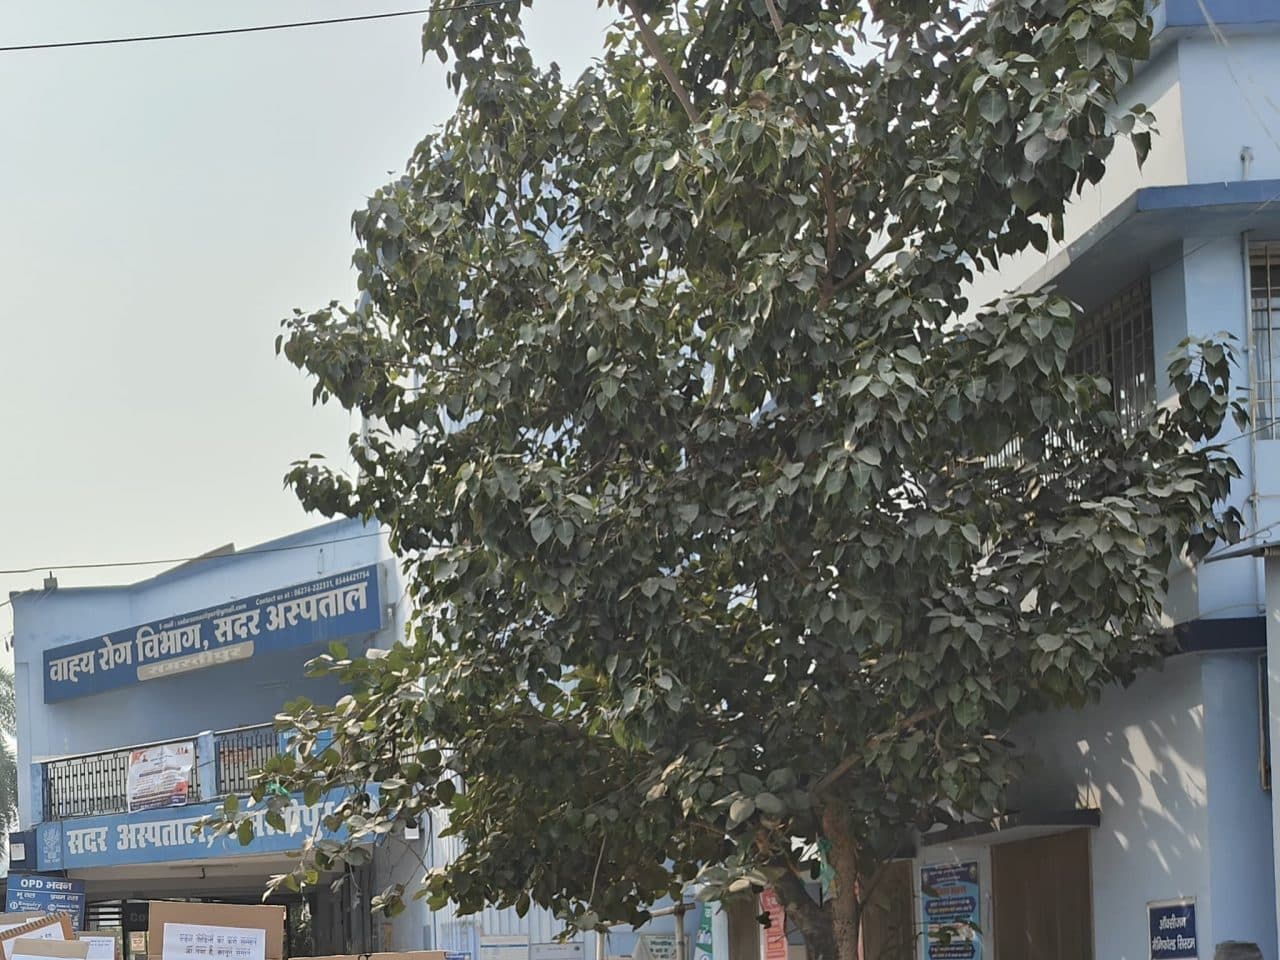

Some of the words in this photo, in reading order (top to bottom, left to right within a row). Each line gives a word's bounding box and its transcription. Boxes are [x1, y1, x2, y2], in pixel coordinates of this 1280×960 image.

[99, 637, 132, 671] रोग
[136, 625, 209, 662] विभाग,
[213, 608, 261, 643] सदर
[266, 580, 369, 630] अस्पताल
[67, 826, 108, 855] सदर
[20, 879, 43, 889] OPD
